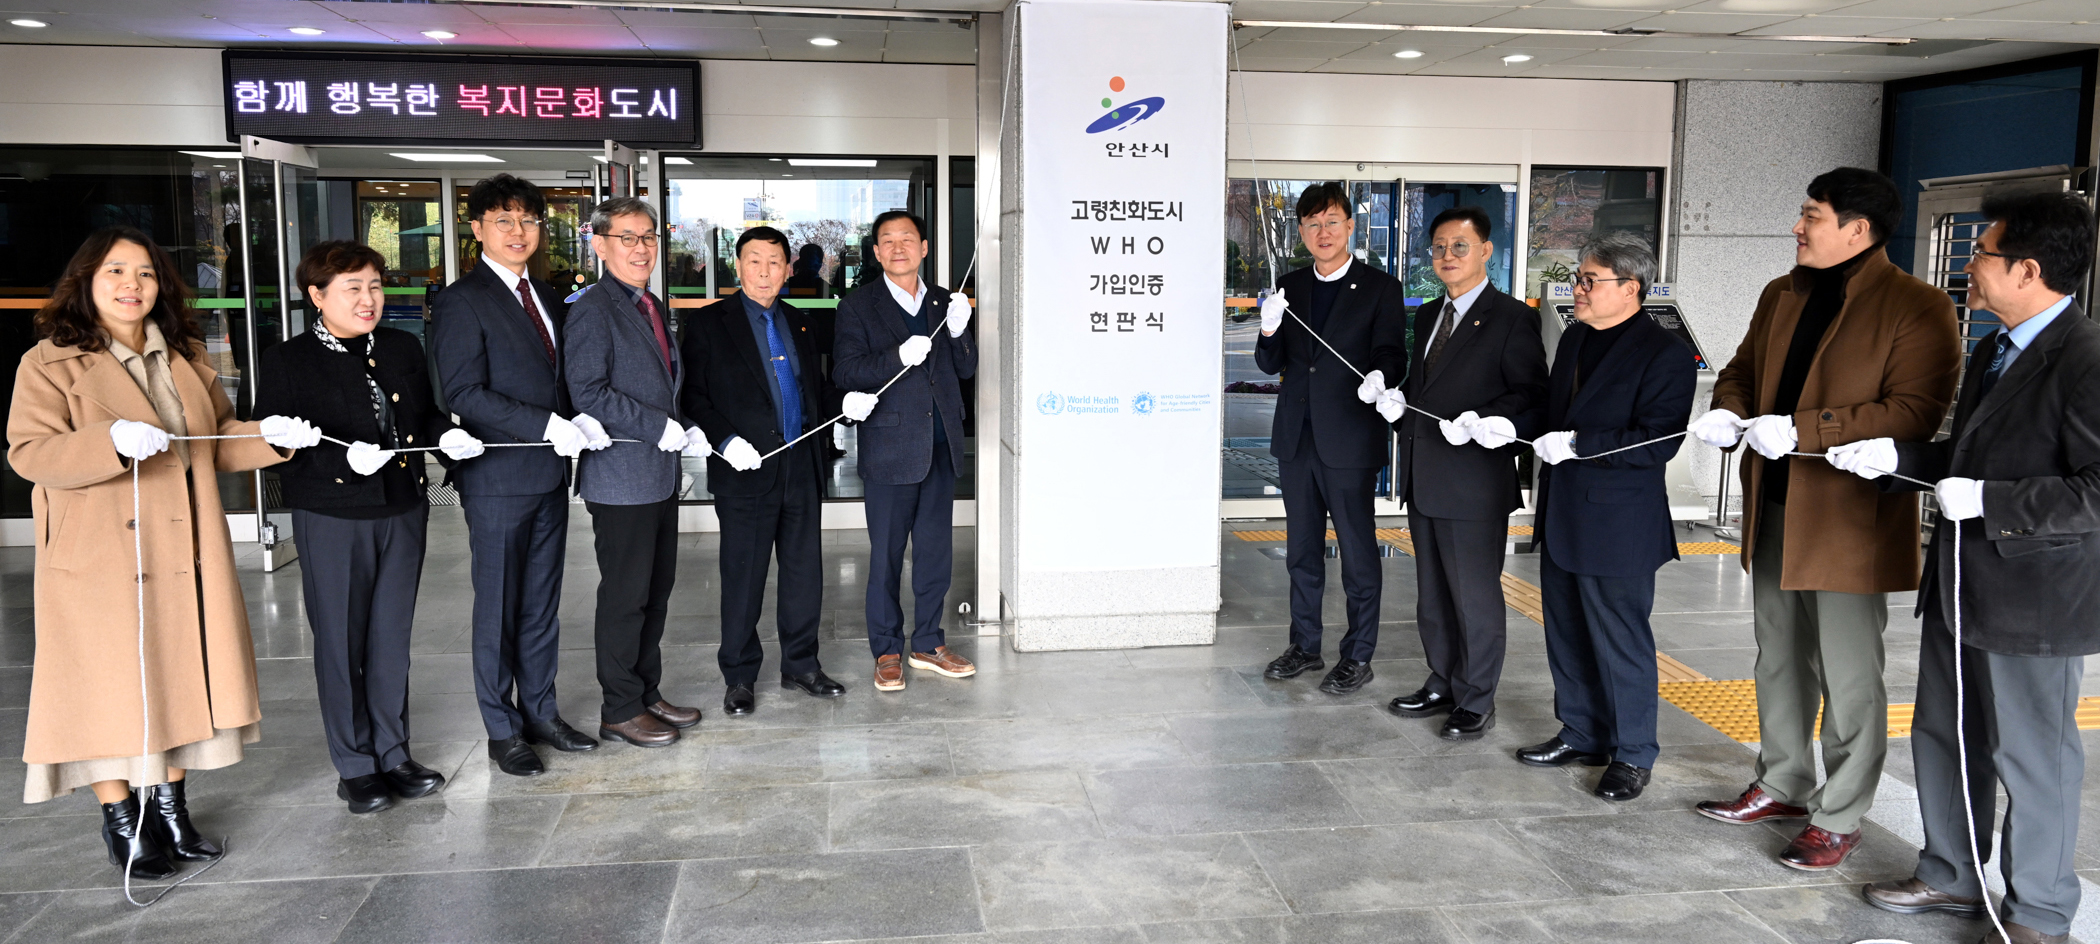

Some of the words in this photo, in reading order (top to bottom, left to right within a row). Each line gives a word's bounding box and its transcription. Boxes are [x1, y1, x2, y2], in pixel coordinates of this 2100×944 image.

[234, 80, 308, 114] 함께
[326, 81, 440, 116] 행복한
[457, 84, 677, 120] 복지문화도시
[1105, 142, 1170, 158] 안산시
[1070, 199, 1183, 222] 고령친화도시
[1089, 273, 1164, 296] 가입인증
[1066, 404, 1119, 415] Organization
[1067, 395, 1091, 404] World
[1093, 395, 1119, 405] Health
